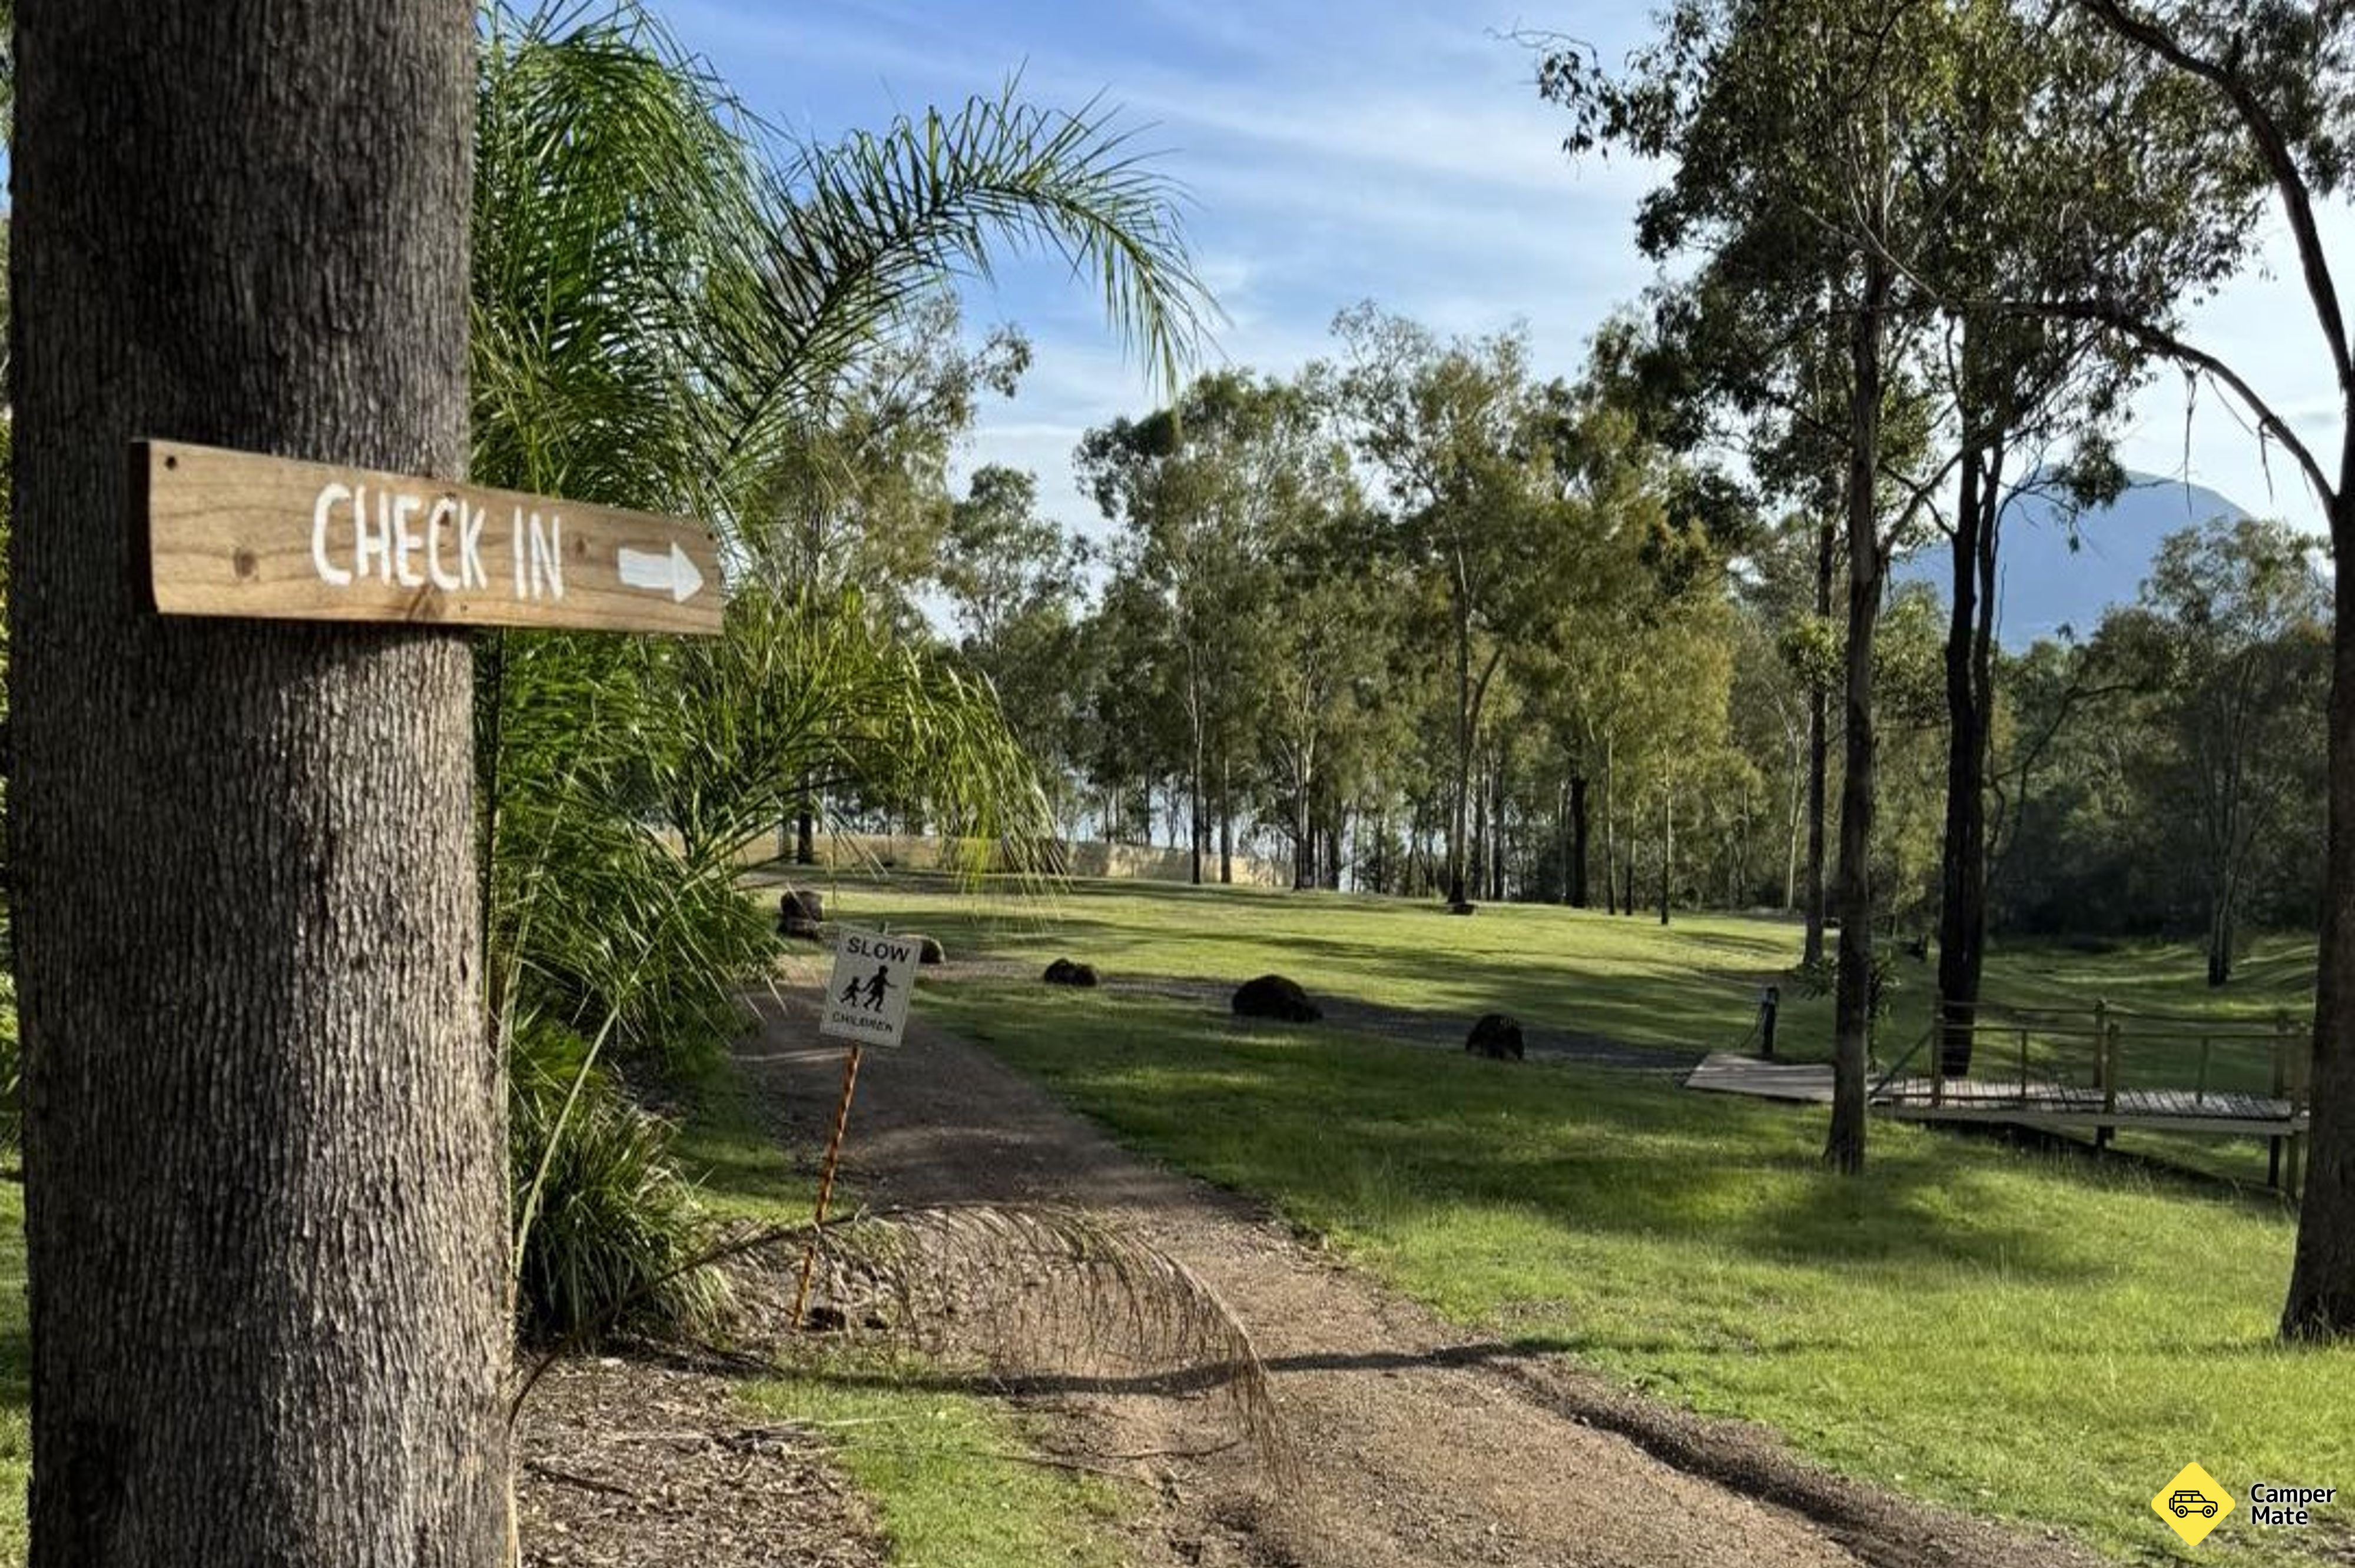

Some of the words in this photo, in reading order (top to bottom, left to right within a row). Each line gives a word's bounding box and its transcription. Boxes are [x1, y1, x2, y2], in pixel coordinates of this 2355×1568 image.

[311, 482, 486, 592] CHECK
[512, 505, 565, 601] IN
[847, 936, 910, 962] SLOW
[832, 1011, 893, 1033] CHILDREN
